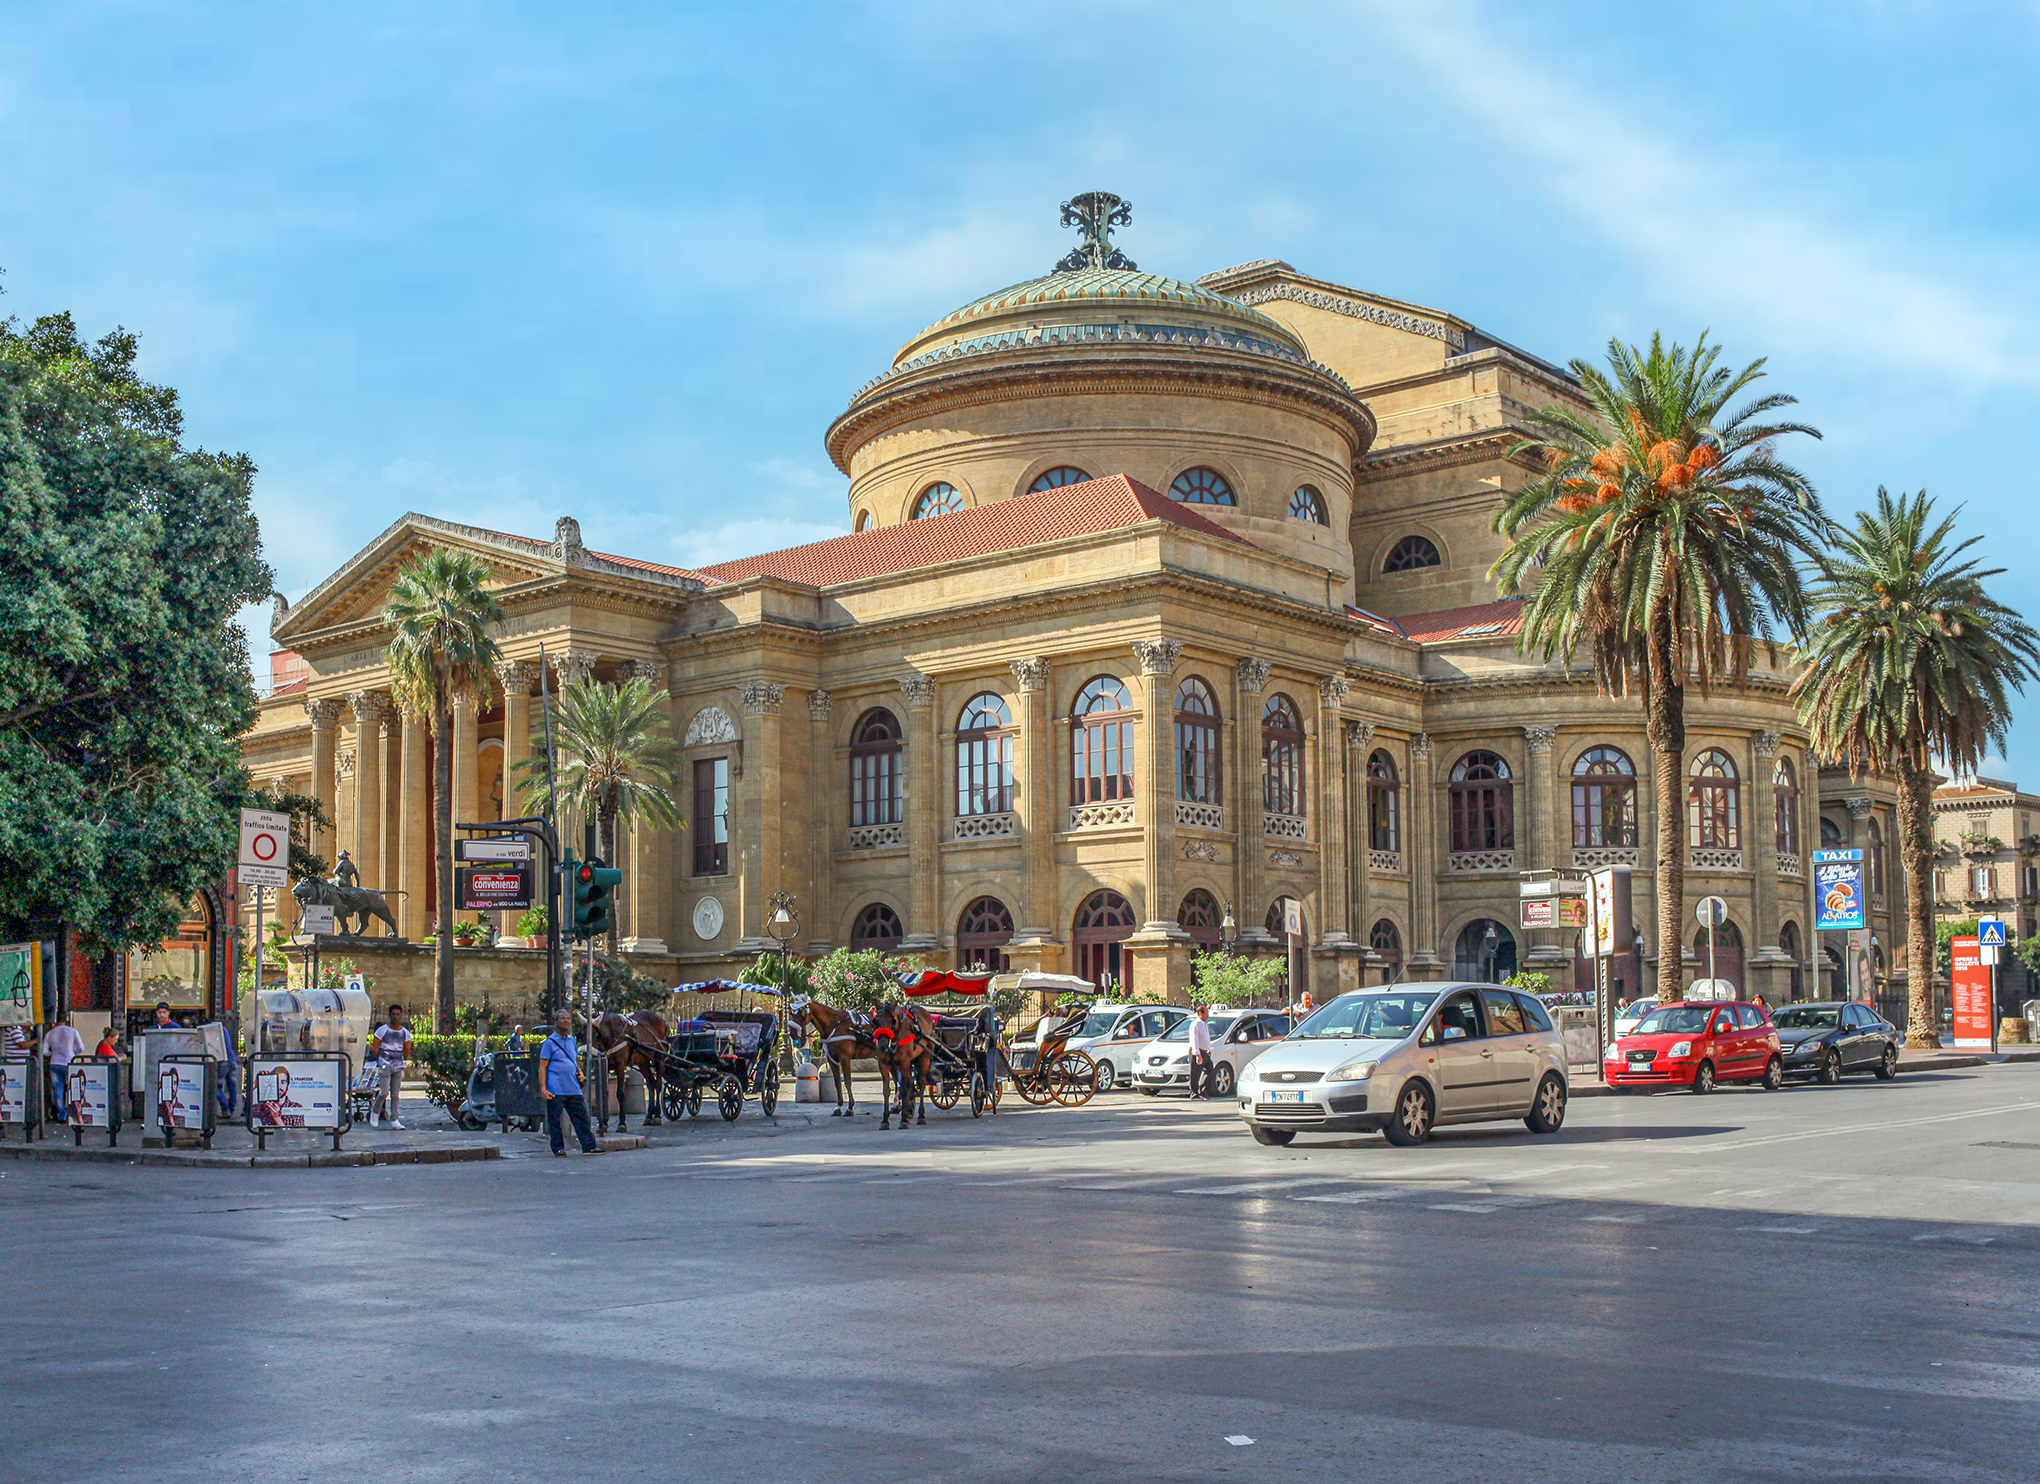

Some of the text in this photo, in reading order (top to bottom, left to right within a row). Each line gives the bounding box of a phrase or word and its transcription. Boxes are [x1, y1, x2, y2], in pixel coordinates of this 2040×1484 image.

[244, 821, 288, 832] traffico limitato
[1821, 851, 1853, 861] TAXI
[474, 880, 519, 889] convenienza
[466, 900, 493, 908] PALERMO
